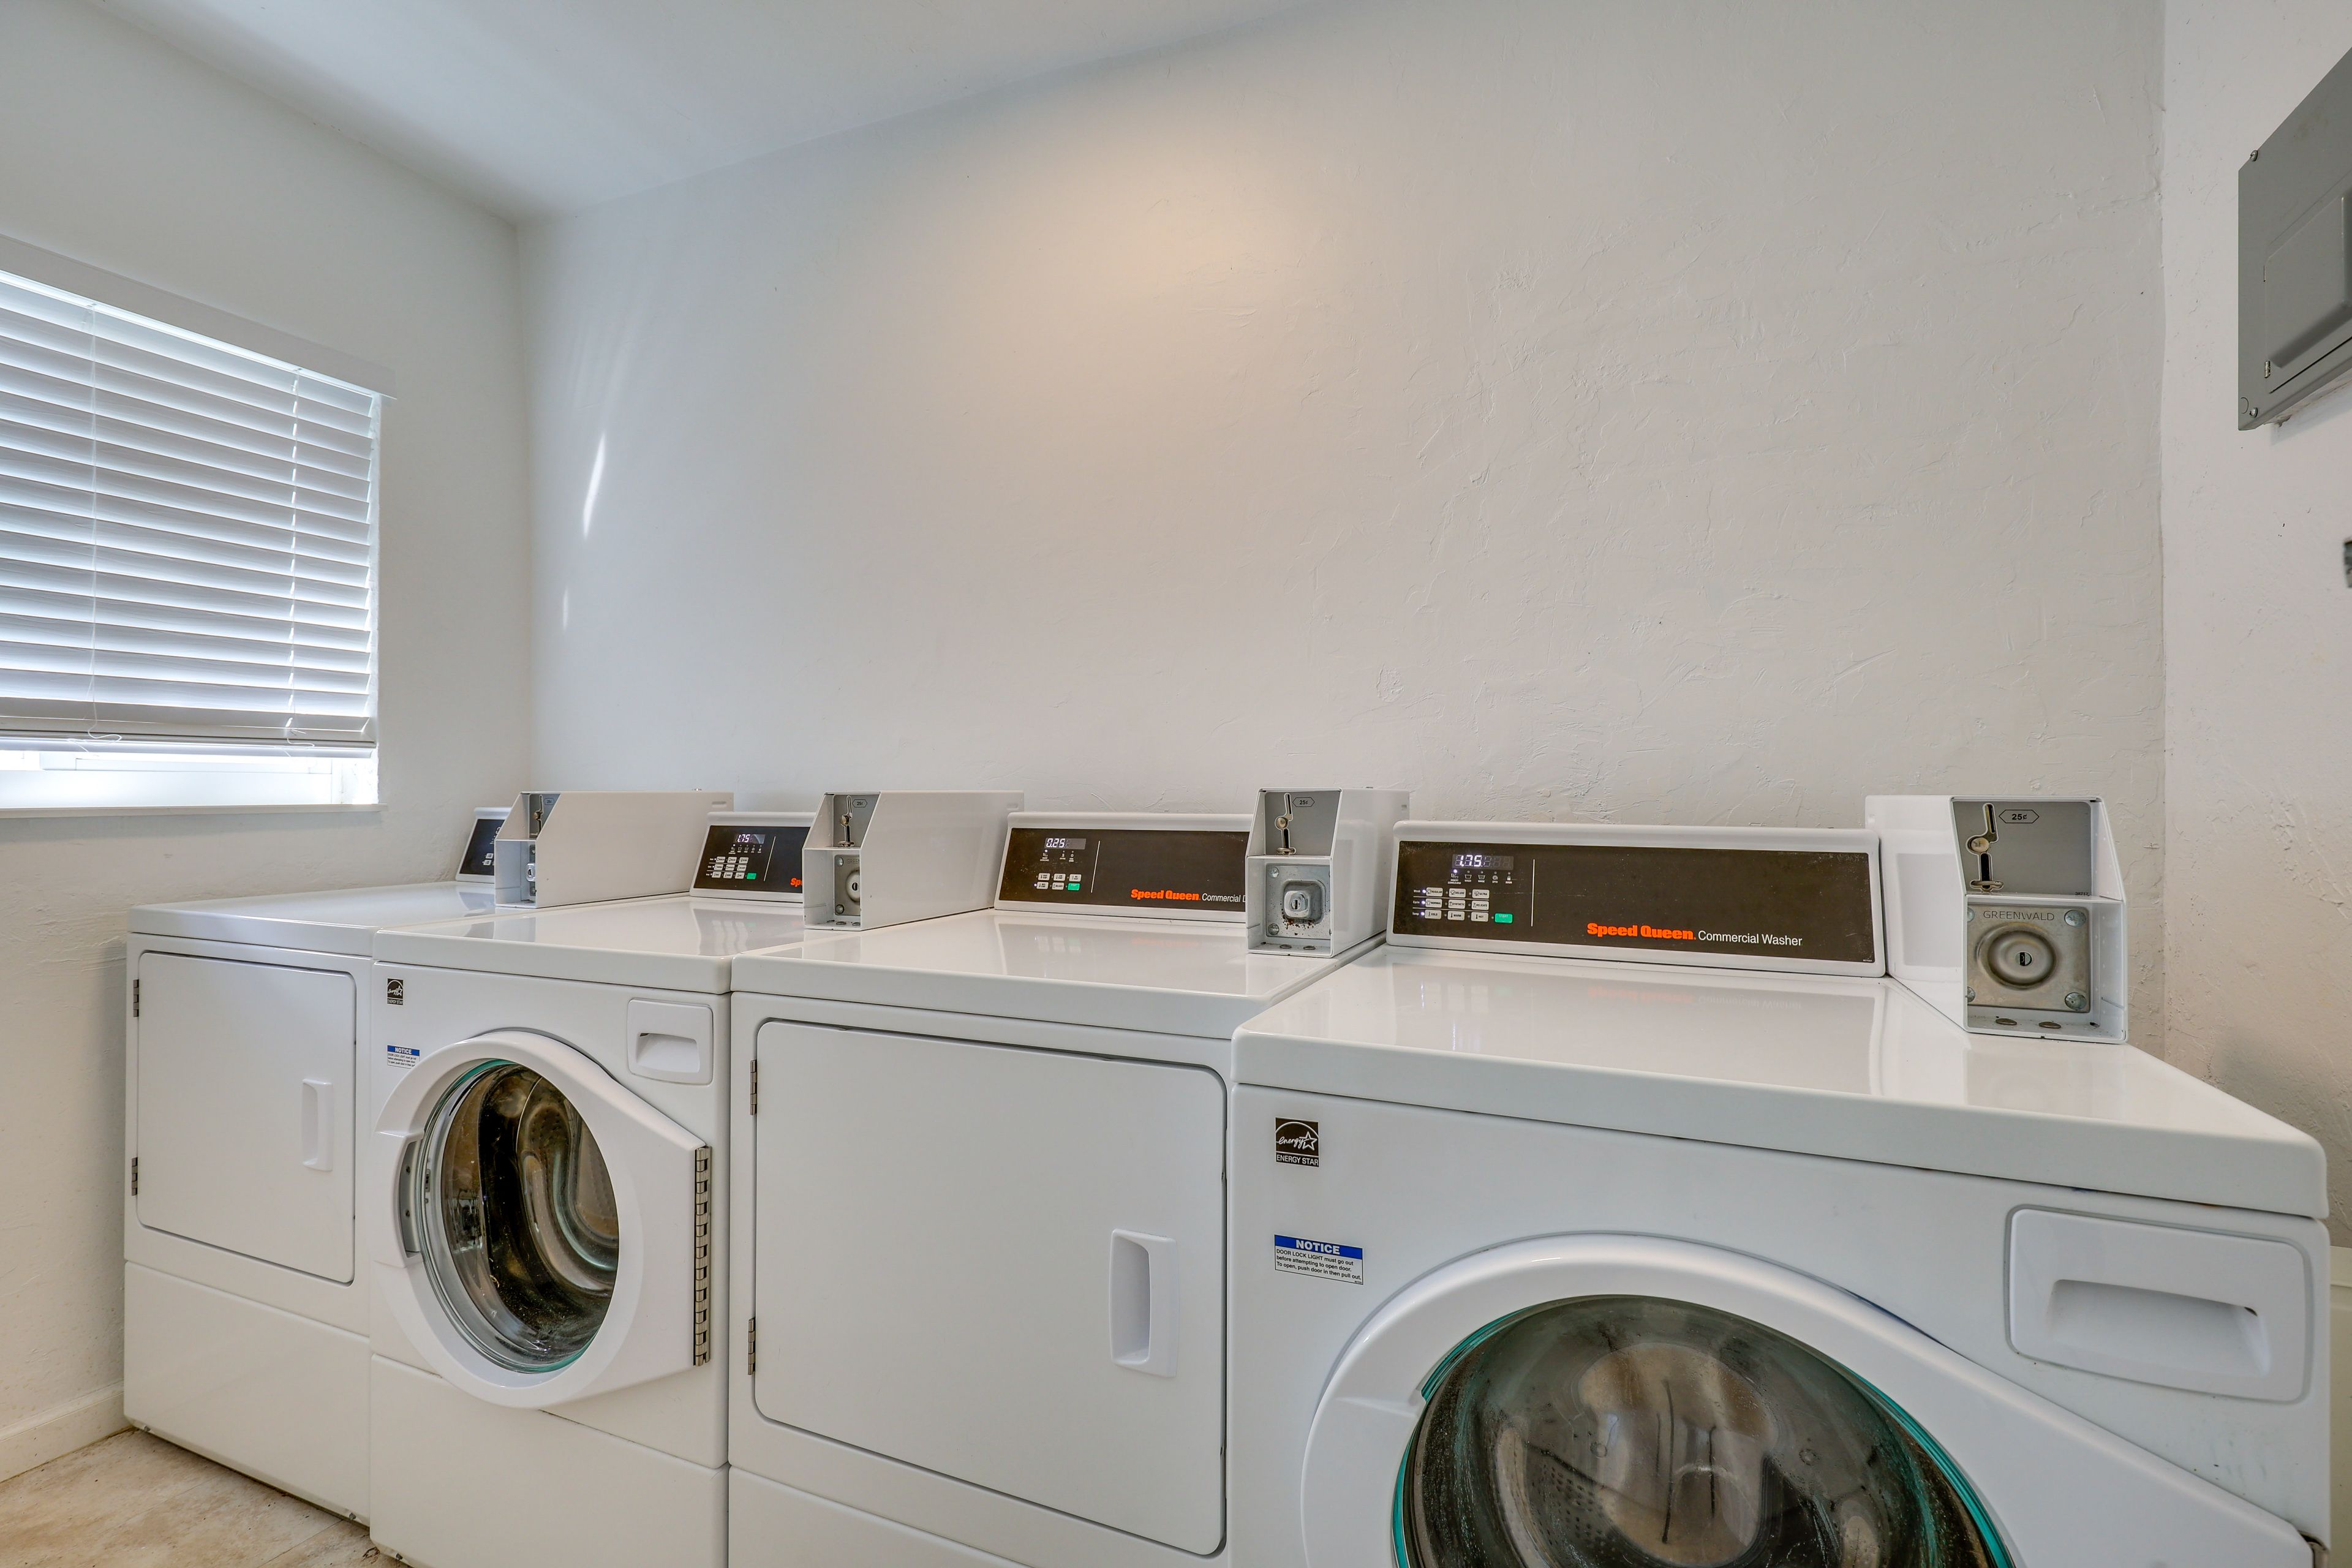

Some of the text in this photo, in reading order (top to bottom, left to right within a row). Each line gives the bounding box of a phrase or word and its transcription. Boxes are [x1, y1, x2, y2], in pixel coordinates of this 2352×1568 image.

[1131, 889, 1164, 900] Speed
[1202, 892, 1241, 903] Commercial
[1983, 910, 2055, 921] GREENWALD
[1587, 923, 1638, 937] Speed
[1698, 930, 1759, 944] Commercial
[1762, 933, 1803, 946] Washer
[1276, 1154, 1319, 1166] ENERGY STAR
[1295, 1240, 1340, 1255] NOTICE
[1292, 1258, 1318, 1267] attempting
